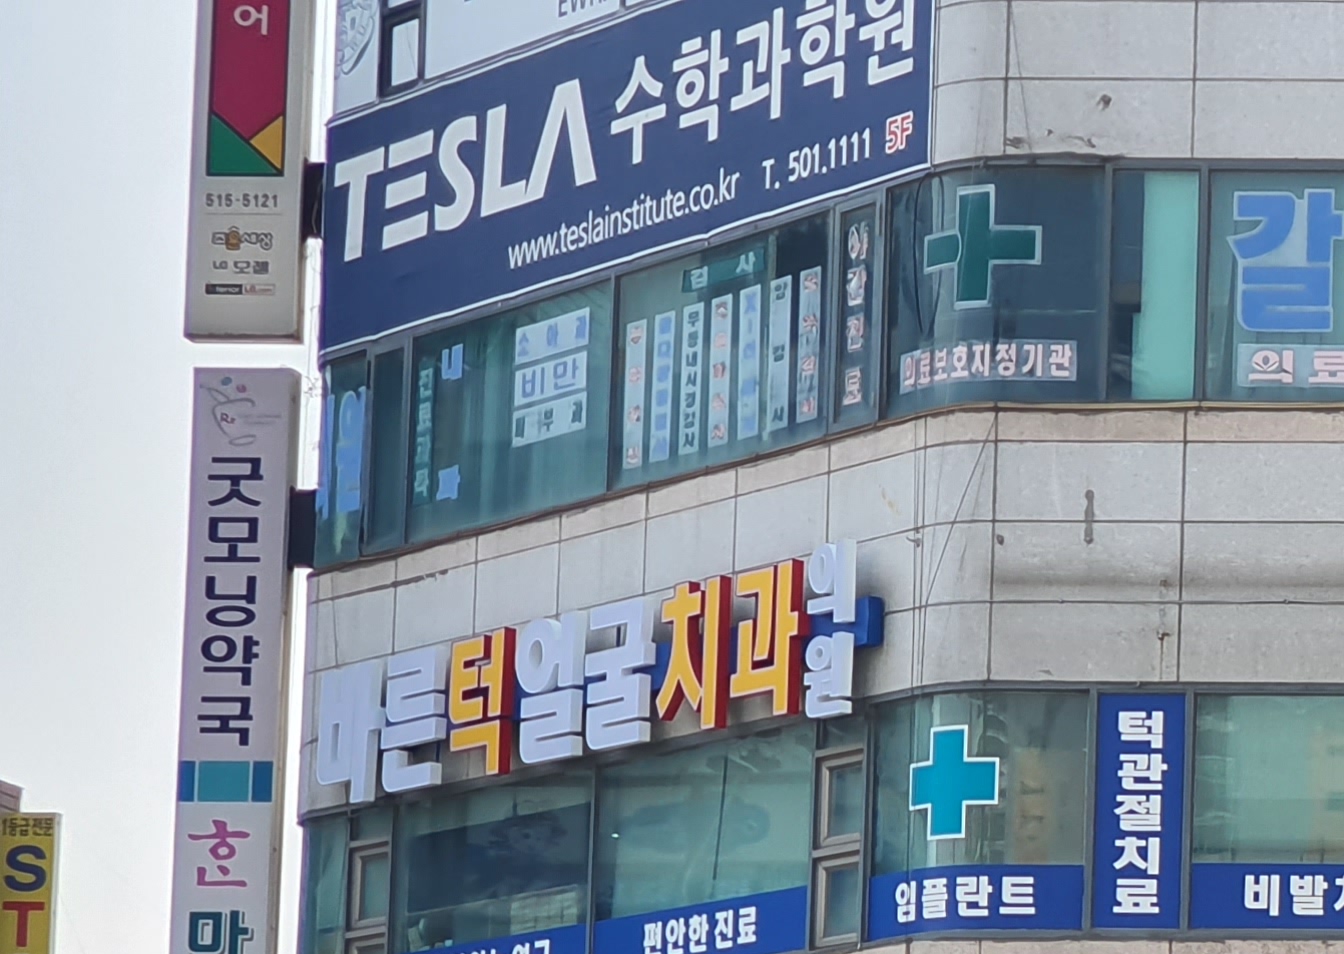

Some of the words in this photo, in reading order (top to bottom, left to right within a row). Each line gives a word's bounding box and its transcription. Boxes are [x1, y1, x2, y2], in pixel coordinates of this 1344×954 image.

[334, 78, 597, 262] TESLA
[610, 0, 915, 164] 수학과학원
[885, 110, 914, 154] 5F
[205, 193, 279, 208] 515-5121
[508, 167, 741, 270] www.teslainstitute.co.kr
[521, 357, 580, 399] 비만
[197, 456, 264, 747] 굿모닝약국
[1113, 710, 1169, 915] 턱관절치료
[894, 875, 1037, 924] 임플란트
[713, 906, 758, 951] 진료
